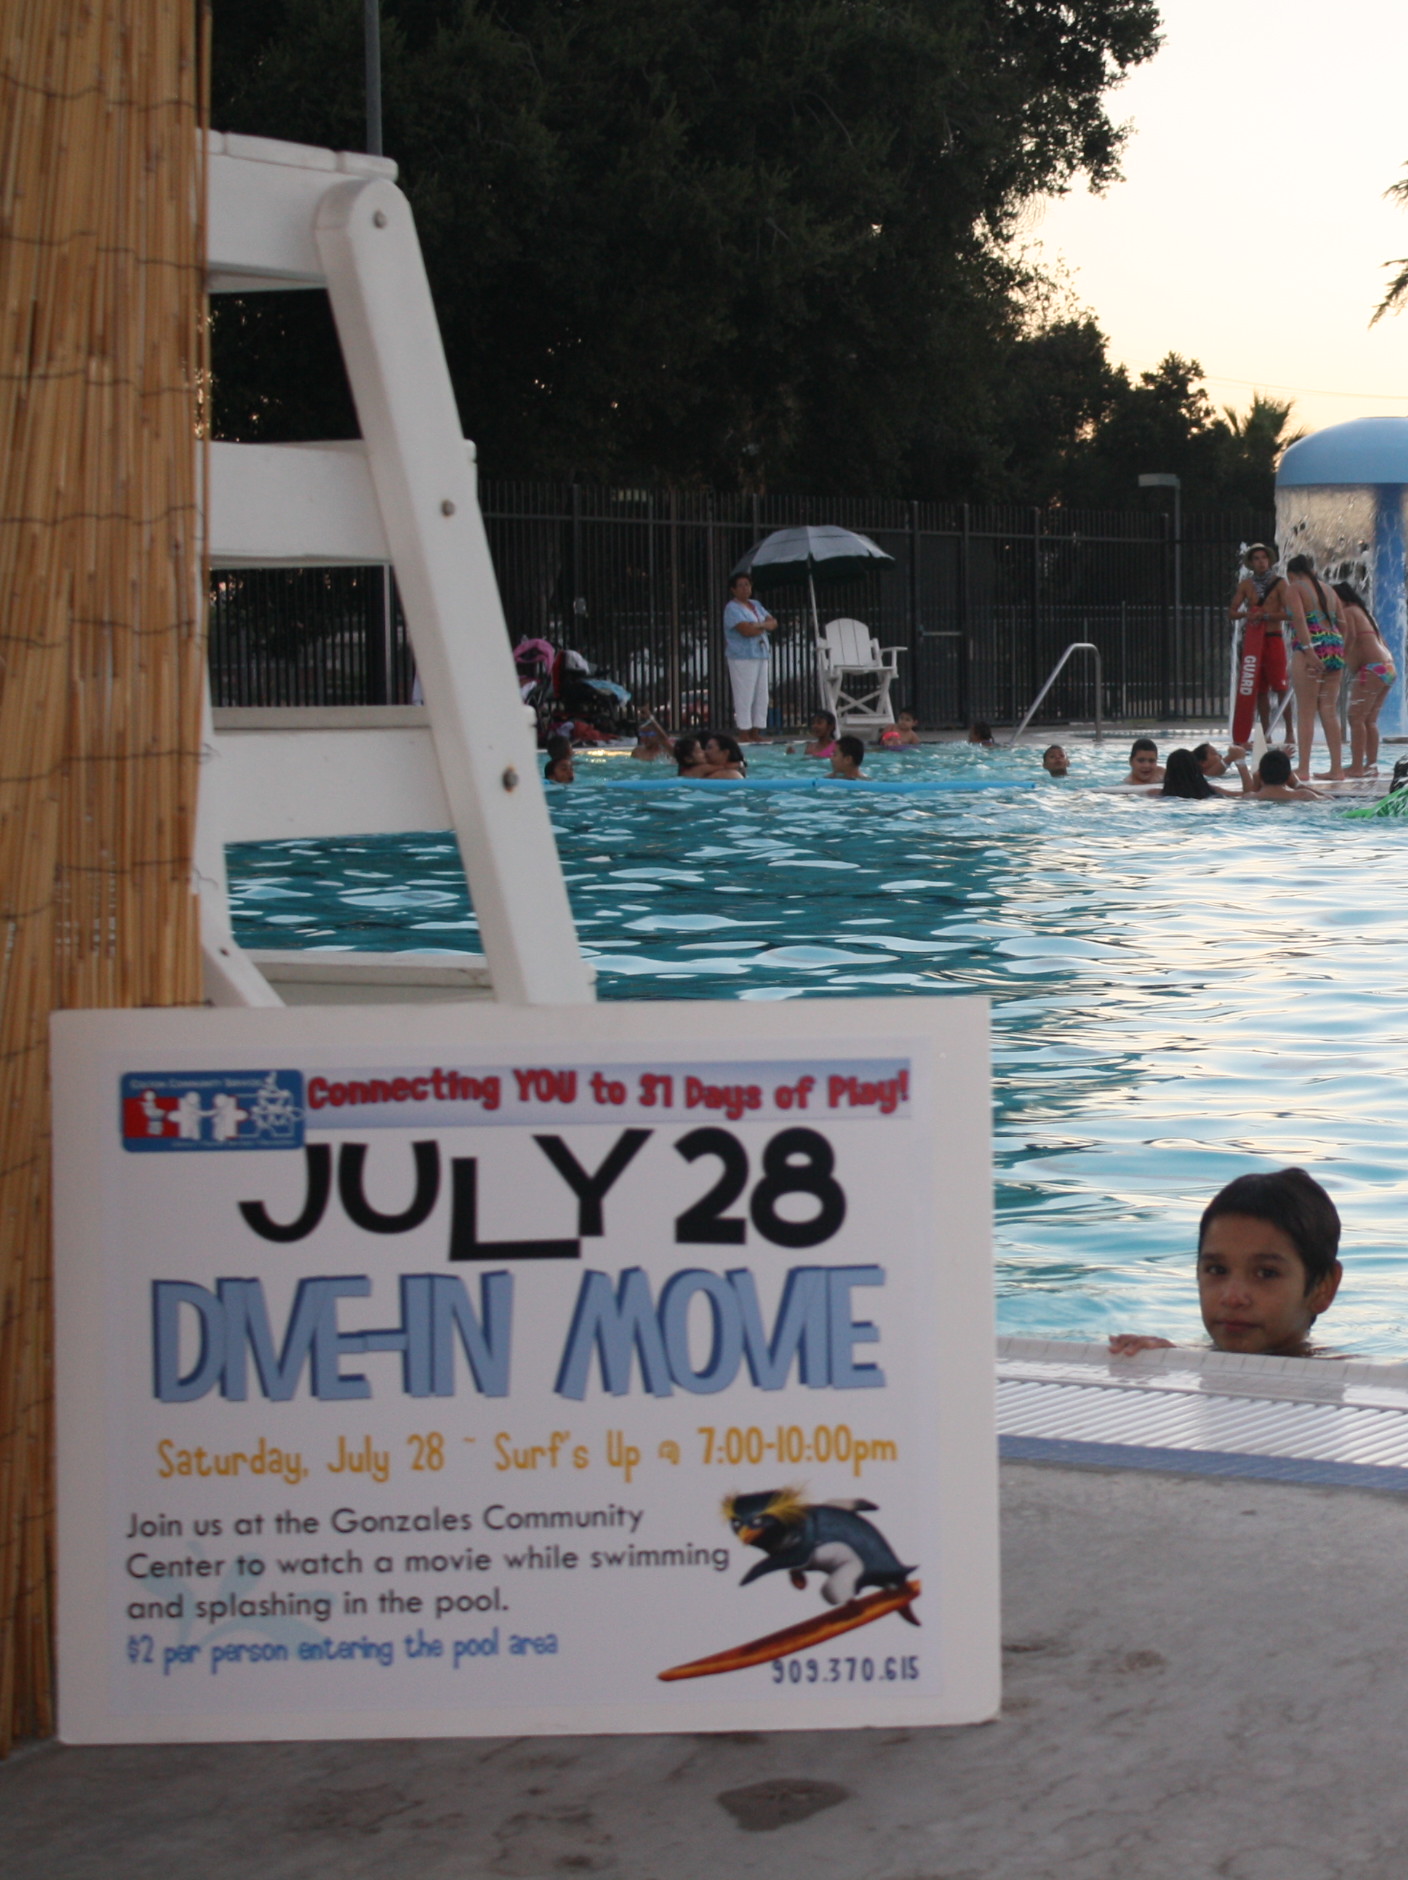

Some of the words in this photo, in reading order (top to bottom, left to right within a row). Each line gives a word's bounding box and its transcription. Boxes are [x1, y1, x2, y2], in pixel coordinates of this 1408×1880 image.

[1240, 655, 1257, 695] GUARD
[307, 1067, 501, 1111] Connecting
[513, 1068, 577, 1104] YOU
[590, 1071, 627, 1105] to
[639, 1073, 674, 1108] 31
[684, 1075, 763, 1120] Days
[773, 1075, 816, 1110] of
[827, 1068, 910, 1114] Play!
[237, 1127, 656, 1261] JULY
[672, 1126, 848, 1249] 28
[152, 1271, 514, 1402] DIVE-IN
[553, 1265, 887, 1402] MOVIE
[157, 1437, 309, 1485] Saturday,
[327, 1435, 391, 1483] July
[406, 1432, 445, 1472] 28
[494, 1430, 589, 1473] Surf's
[606, 1430, 641, 1483] Up
[698, 1426, 898, 1477] 7:00-10:00pm
[126, 1513, 183, 1539] Join
[193, 1518, 223, 1536] us
[234, 1513, 265, 1536] at
[275, 1510, 320, 1534] the
[331, 1507, 473, 1534] Gonzales
[483, 1504, 645, 1532] Community
[126, 1552, 226, 1579] Center
[236, 1555, 266, 1577] to
[277, 1550, 363, 1575] watch
[374, 1555, 394, 1575] a
[405, 1547, 493, 1572] movie
[502, 1544, 579, 1570] while
[590, 1542, 731, 1571] swimming
[127, 1593, 184, 1619] and
[195, 1591, 332, 1624] splashing
[343, 1591, 368, 1615] in
[378, 1588, 423, 1614] the
[435, 1587, 510, 1619] pool.
[126, 1634, 155, 1663] $2
[162, 1643, 200, 1676] per
[211, 1641, 289, 1675] person
[299, 1635, 394, 1667] entering
[404, 1628, 444, 1659] the
[452, 1626, 500, 1670] pool
[508, 1631, 559, 1656] area
[771, 1655, 921, 1684] 909.370.615
